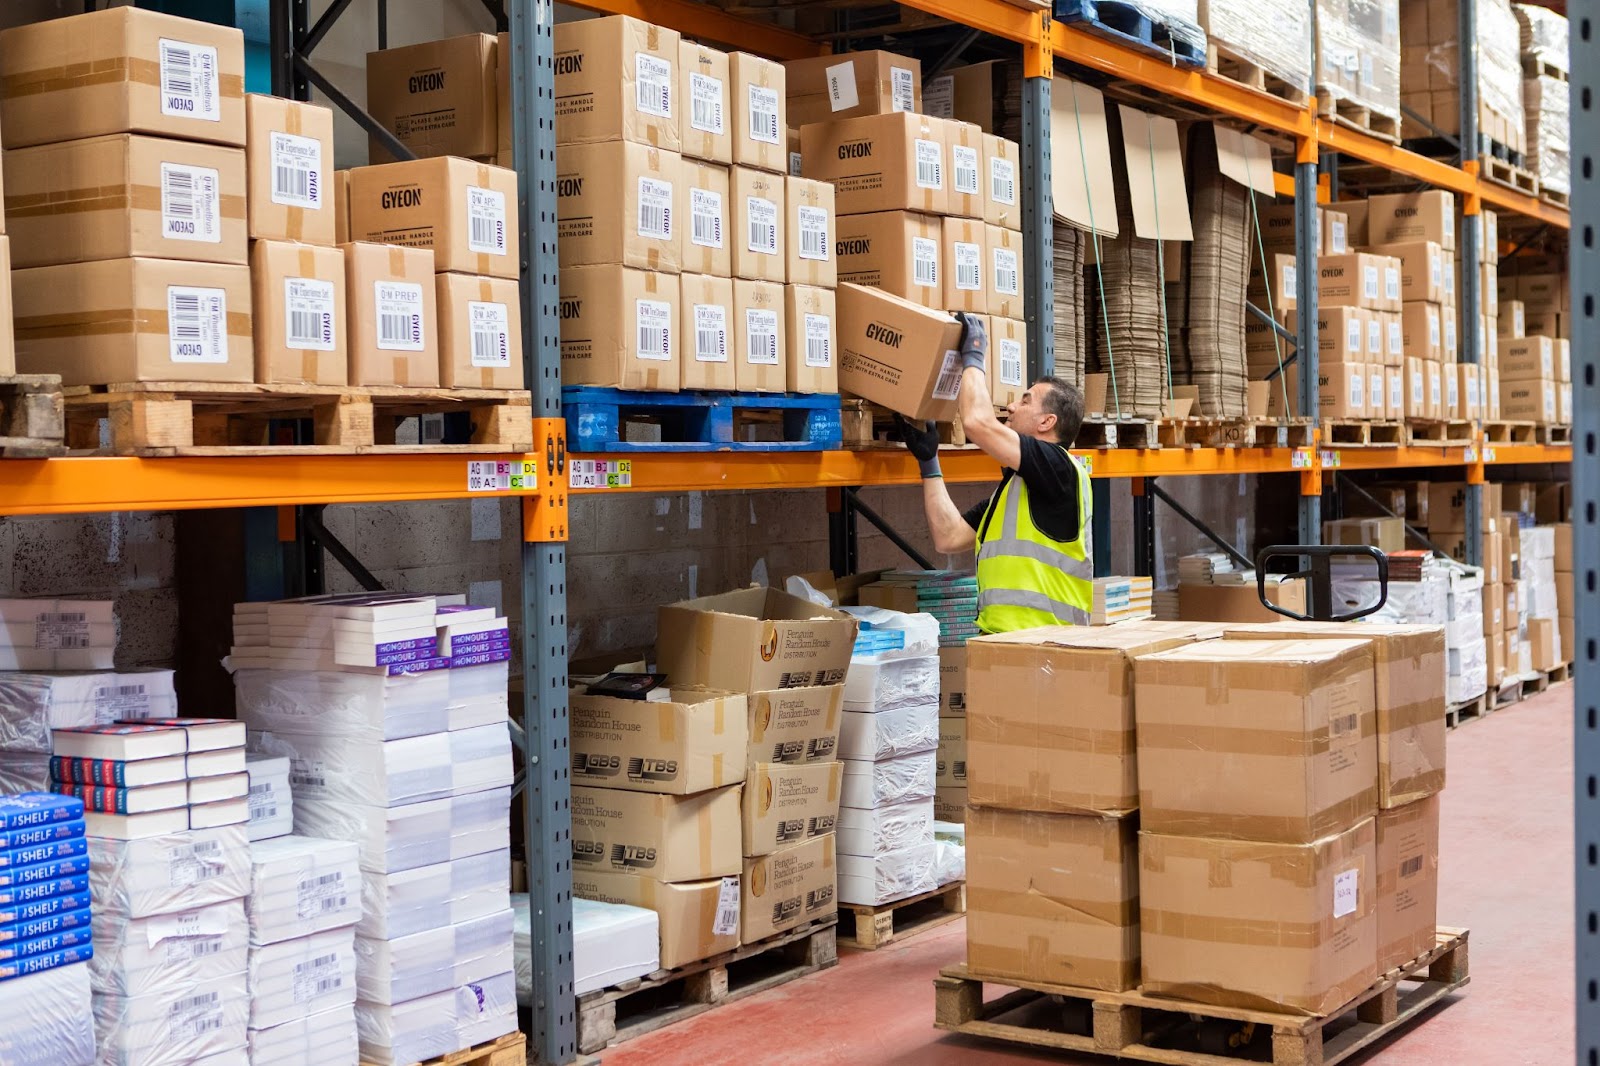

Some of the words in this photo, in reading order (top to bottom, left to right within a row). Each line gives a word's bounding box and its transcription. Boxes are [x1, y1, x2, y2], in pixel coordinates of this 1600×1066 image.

[554, 55, 582, 75] YEON
[409, 72, 444, 93] GYEON
[168, 97, 194, 112] GYEON
[559, 107, 577, 115] EXTRA
[838, 142, 873, 160] GYEON
[309, 171, 318, 202] GYEON
[557, 179, 582, 197] EON
[382, 189, 421, 209] GYEON
[484, 197, 496, 207] APC
[169, 221, 195, 234] GYEON
[409, 231, 434, 240] HANDLE
[836, 239, 870, 256] GYEON
[1321, 269, 1344, 278] GYEON
[395, 291, 418, 301] PREP
[486, 311, 498, 320] APC
[323, 313, 331, 343] GYEON
[412, 314, 420, 343] GYEON
[866, 323, 903, 349] GYEON
[177, 344, 202, 356] GYEON
[499, 332, 507, 360] GYEON
[855, 365, 867, 375] WITH
[867, 370, 884, 382] EXTRA
[885, 376, 899, 386] CARE
[857, 359, 877, 370] PLEASE
[880, 367, 901, 380] HANDLE
[1225, 429, 1240, 440] KD
[471, 463, 480, 475] AG
[497, 464, 504, 473] B
[524, 464, 531, 473] D
[573, 462, 581, 473] AG
[596, 463, 602, 471] B
[620, 463, 626, 471] D
[471, 479, 481, 489] 006
[484, 478, 490, 487] A
[511, 478, 518, 487] C
[572, 475, 582, 486] 007
[584, 477, 590, 485] A
[608, 476, 614, 484] C
[455, 632, 488, 643] HONOURS
[787, 630, 814, 640] Penguin
[381, 641, 416, 652] HONOURS
[455, 643, 490, 654] HONOURS
[785, 639, 812, 649] Random
[812, 639, 831, 648] House
[381, 652, 416, 663] HONOURS
[455, 653, 490, 665] HONOURS
[784, 651, 817, 659] DISTRIBUTION
[393, 662, 429, 673] HONOURS
[939, 665, 958, 673] ouse
[790, 672, 811, 683] GBS
[826, 669, 845, 680] TBS
[780, 700, 804, 710] Penguin
[573, 707, 611, 721] Penguin
[778, 709, 802, 719] Random
[803, 708, 821, 717] House
[573, 718, 611, 730] Random
[612, 720, 641, 732] House
[777, 721, 808, 729] DISTRIBUTION
[573, 731, 622, 741] DISTRIBUTION
[817, 736, 835, 749] TBS
[784, 741, 804, 753] GBS
[589, 754, 620, 768] GBS
[645, 759, 678, 773] TBS
[779, 777, 802, 788] Penguin
[779, 788, 800, 797] Random
[801, 786, 818, 794] House
[570, 795, 594, 809] nguin
[779, 798, 807, 807] DISTRIBUTION
[18, 811, 49, 826] SHELF
[570, 806, 594, 816] ndom
[595, 806, 623, 819] House
[571, 819, 606, 828] TRIBUTION
[785, 819, 804, 832] GBS
[817, 815, 834, 827] TBS
[21, 829, 52, 845] SHELF
[576, 840, 604, 854] GBS
[626, 845, 657, 860] TBS
[22, 847, 54, 863] SHELF
[774, 856, 797, 870] Penguin
[25, 866, 56, 882] SHELF
[774, 867, 797, 880] Random
[797, 861, 814, 872] House
[573, 882, 597, 893] nguin
[774, 875, 803, 890] DISTRIBUTION
[25, 883, 55, 899] SHELF
[815, 884, 833, 900] TBS
[599, 895, 626, 905] House
[783, 895, 802, 911] GBS
[28, 901, 58, 917] SHELF
[28, 919, 59, 935] SHELF
[28, 937, 58, 954] SHELF
[29, 954, 60, 971] SHELF
